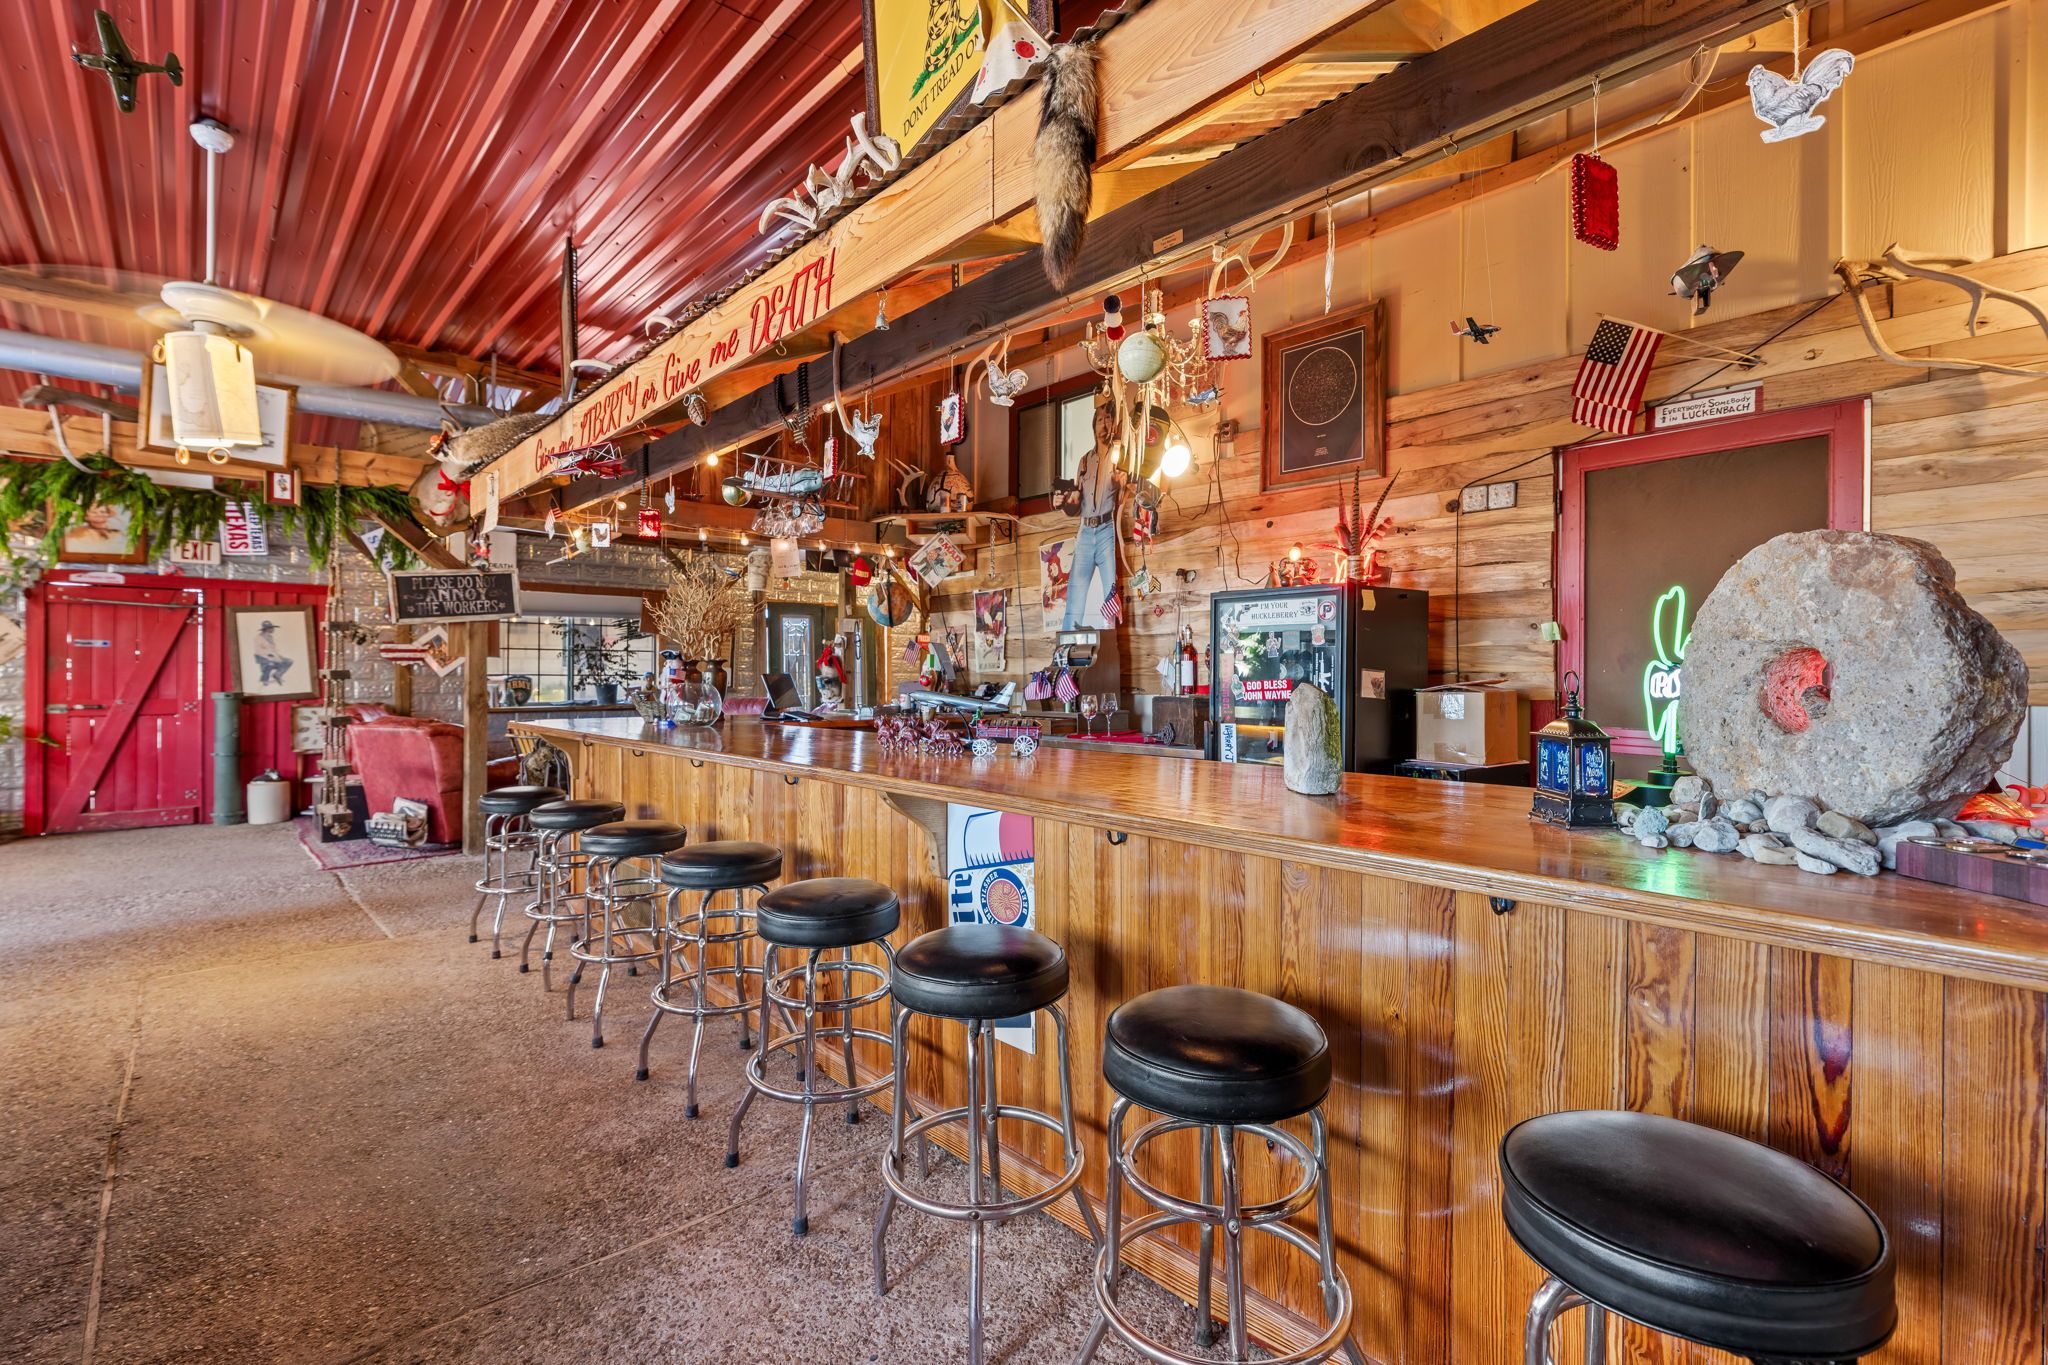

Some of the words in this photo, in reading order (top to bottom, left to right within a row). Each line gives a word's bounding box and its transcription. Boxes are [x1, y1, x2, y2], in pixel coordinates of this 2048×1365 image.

[903, 94, 929, 137] DONT
[930, 53, 963, 102] TREAD
[641, 382, 658, 409] or
[663, 352, 701, 401] Give
[709, 329, 739, 368] me
[749, 247, 836, 354] DEATH
[1682, 403, 1751, 420] LUCKENBACH
[181, 542, 213, 560] EXIT
[942, 542, 962, 563] MAD
[412, 577, 455, 590] PLEASE
[457, 576, 474, 588] DO
[425, 588, 487, 602] ANNOY
[415, 602, 440, 615] THE
[443, 600, 499, 614] WORKERS
[1251, 611, 1299, 620] HUCKLEBERRY
[1246, 681, 1262, 690] GOD
[1264, 680, 1288, 689] BLESS
[1243, 691, 1263, 700] JOHN
[1264, 690, 1292, 700] WAYNE
[981, 871, 999, 903] PILSNER
[951, 873, 983, 924] ite
[1019, 887, 1028, 915] BEER
